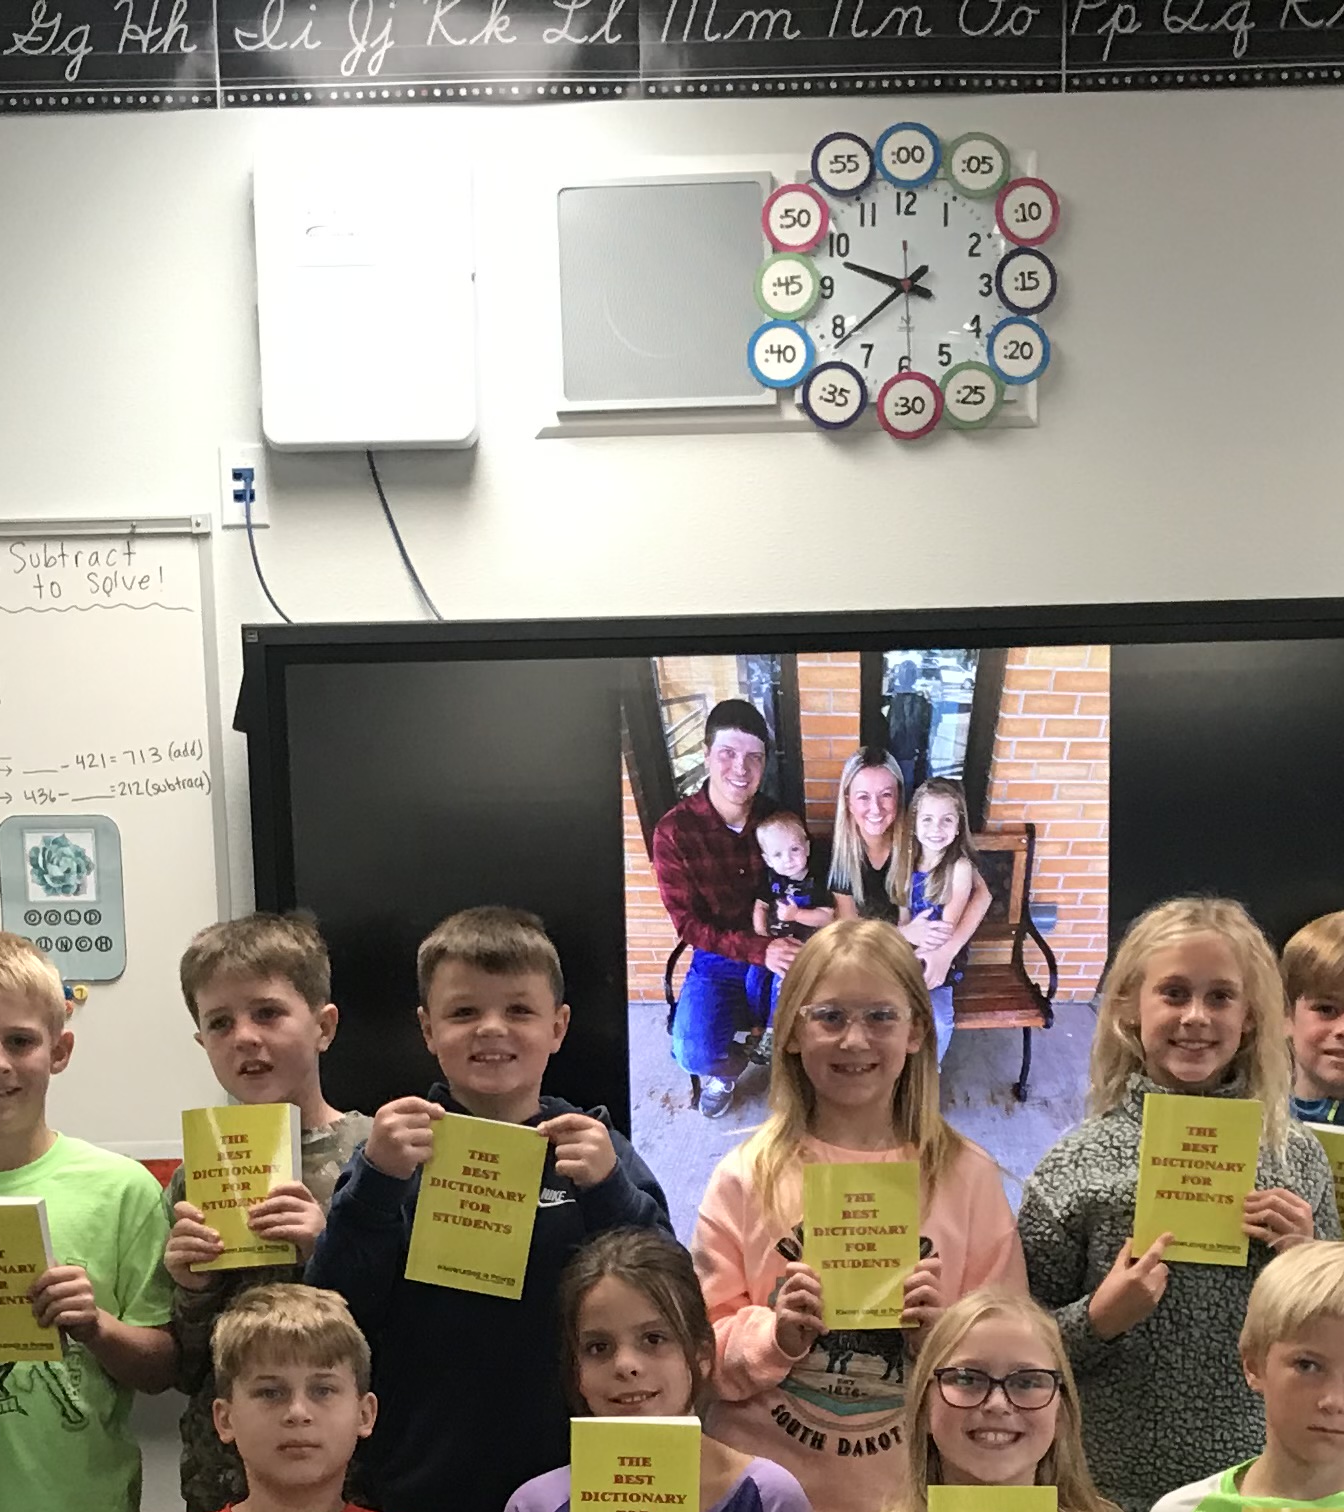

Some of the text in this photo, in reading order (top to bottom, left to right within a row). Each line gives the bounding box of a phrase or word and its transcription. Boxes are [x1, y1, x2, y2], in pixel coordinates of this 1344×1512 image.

[830, 155, 859, 174] :55
[892, 146, 924, 164] :00
[962, 156, 993, 174] :05
[897, 192, 916, 215] 12
[1015, 202, 1041, 222] :10
[780, 209, 810, 228] :50
[773, 276, 802, 295] :45
[980, 275, 992, 297] 3
[1015, 271, 1039, 291] :15
[765, 345, 796, 363] :40
[1004, 340, 1033, 359] :20
[821, 384, 850, 406] :35
[956, 386, 985, 405] :25
[895, 396, 925, 415] :30
[10, 541, 136, 573] Subtract
[33, 575, 61, 599] to
[123, 748, 162, 766] 713
[168, 739, 203, 760] (add)
[540, 1190, 567, 1201] NIKE
[771, 1404, 828, 1451] SOUTH
[617, 1456, 651, 1468] THE
[614, 1474, 655, 1485] BEST
[581, 1491, 687, 1505] DICTIONARY
